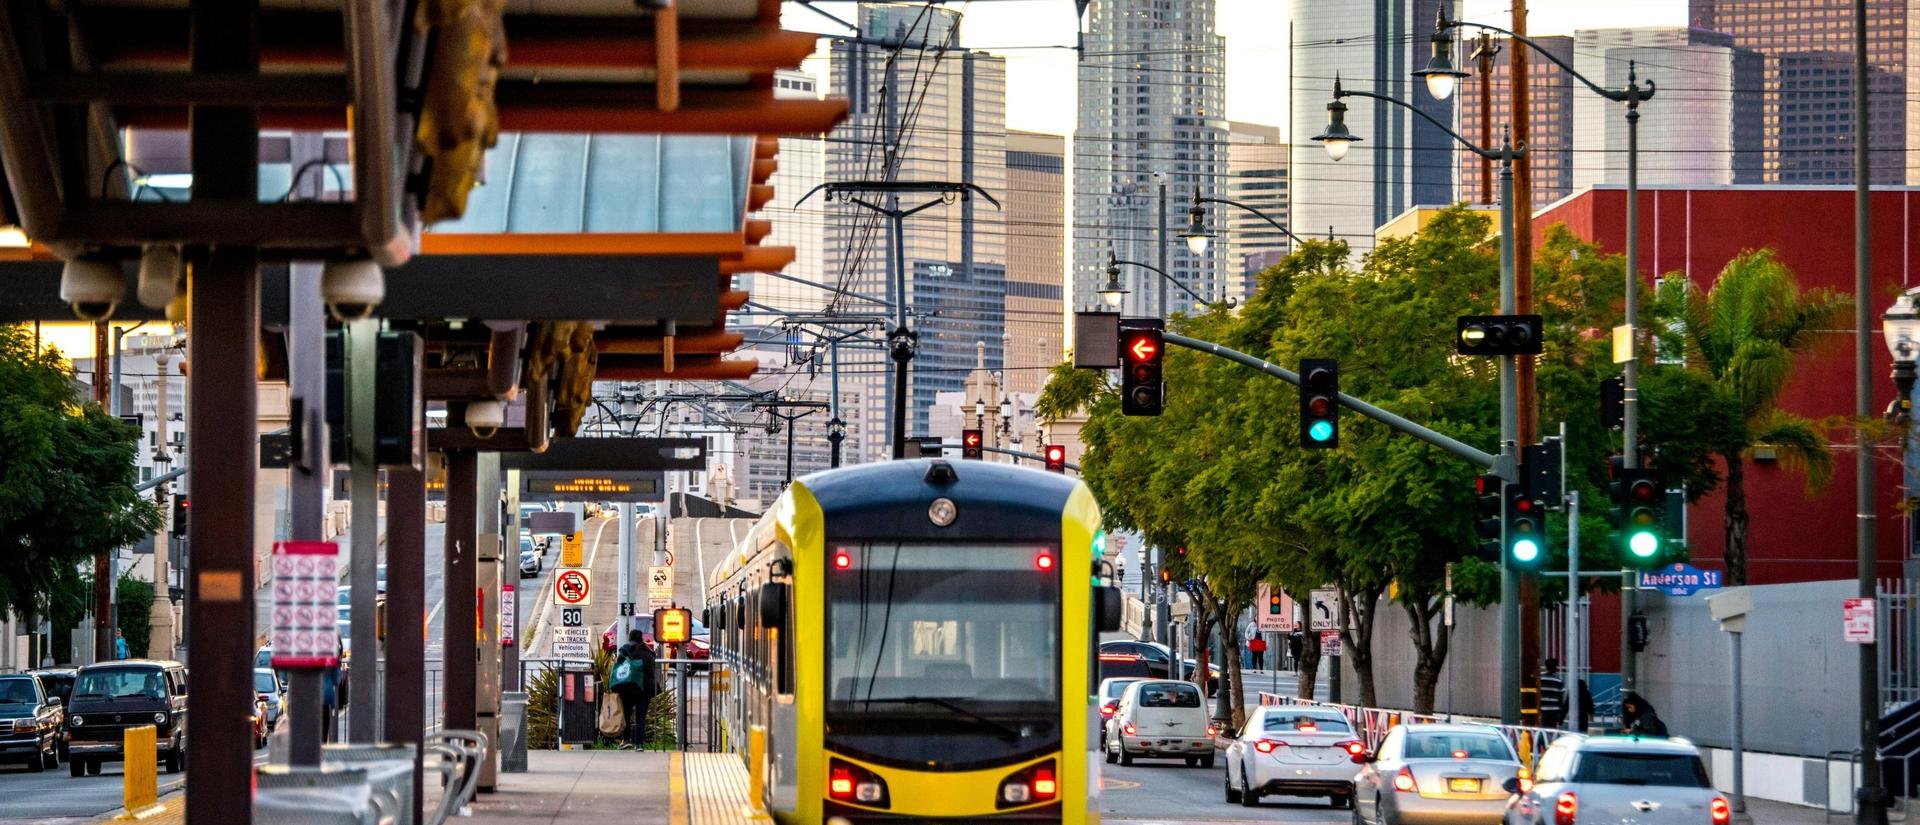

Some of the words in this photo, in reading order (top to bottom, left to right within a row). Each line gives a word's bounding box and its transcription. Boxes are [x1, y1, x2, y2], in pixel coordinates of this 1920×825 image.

[1642, 572, 1698, 585] Anderson
[1703, 571, 1717, 585] St
[564, 611, 581, 624] 30
[1312, 620, 1331, 628] ONLY
